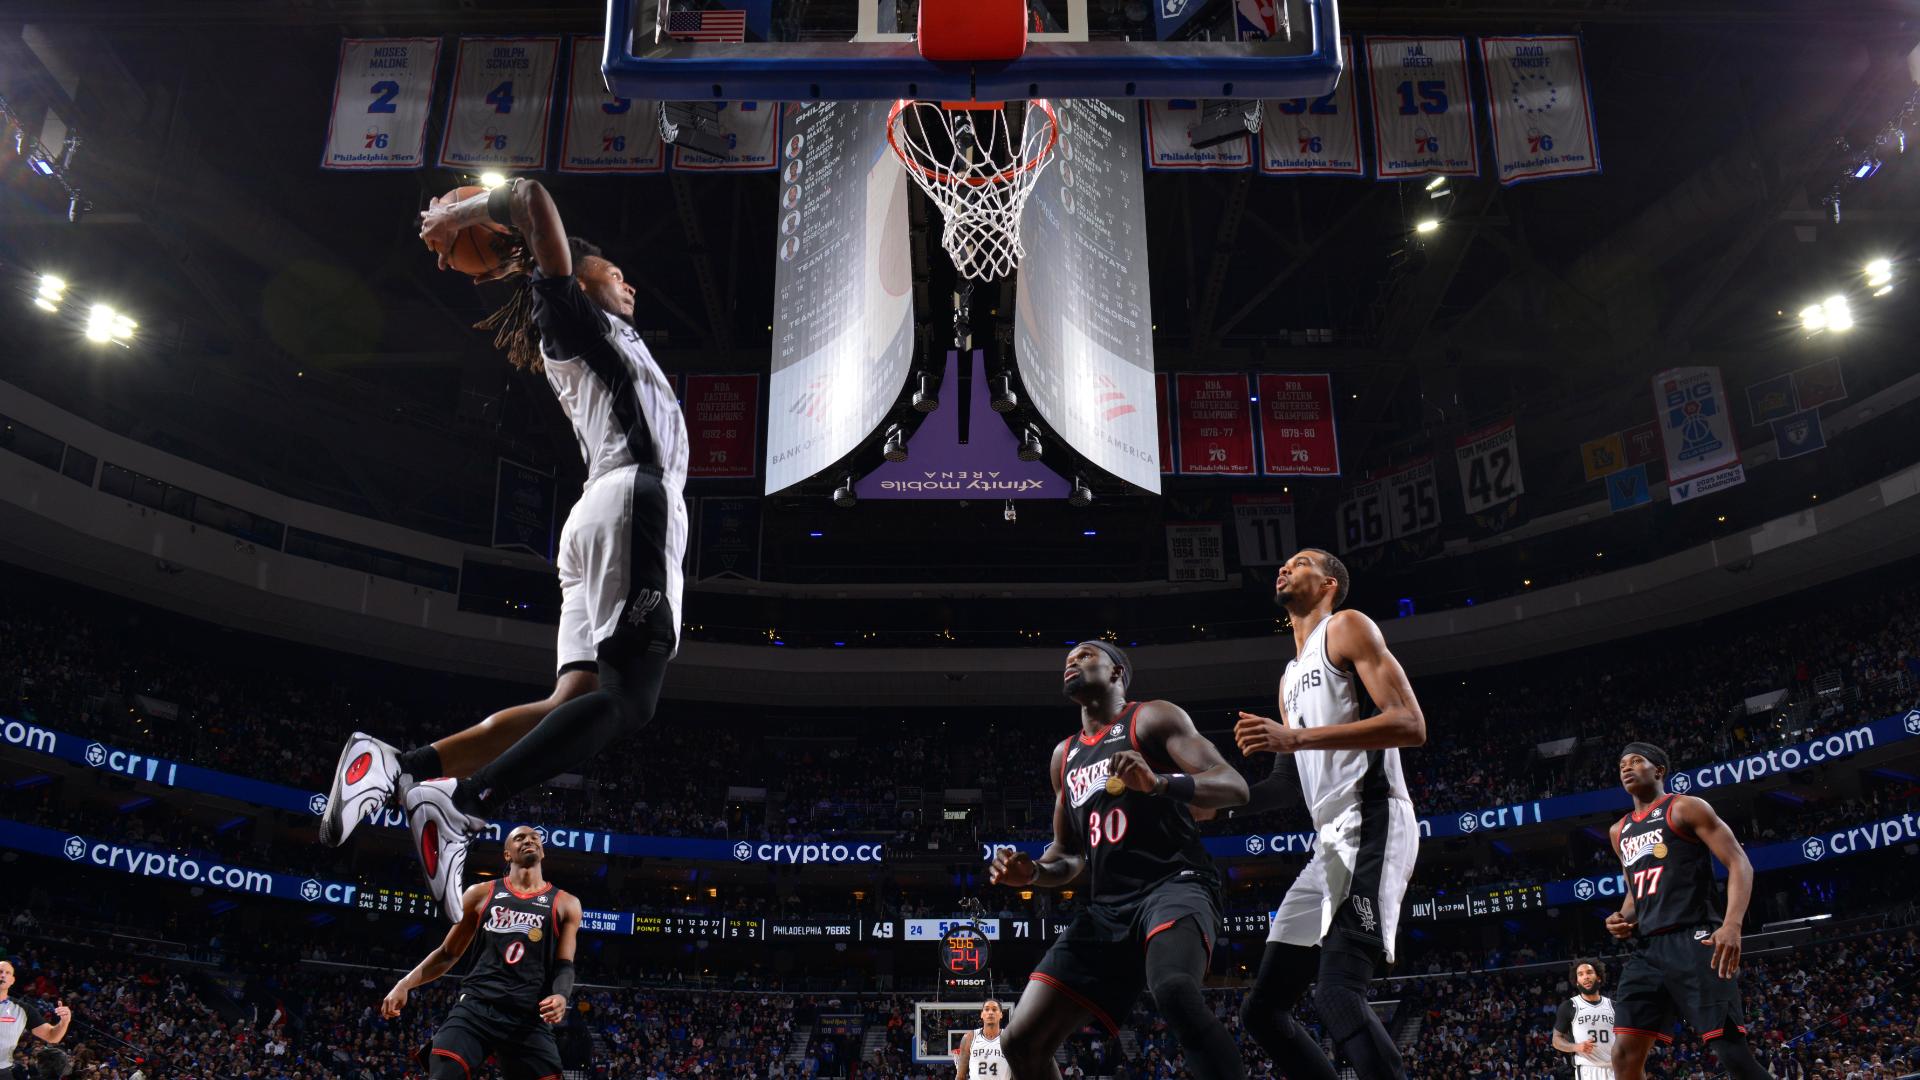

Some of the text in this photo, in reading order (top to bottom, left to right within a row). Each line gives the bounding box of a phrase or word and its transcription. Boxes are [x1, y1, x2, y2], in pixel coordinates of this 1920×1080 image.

[374, 47, 407, 57] MOSES
[493, 47, 525, 57] DOLPH
[1407, 46, 1426, 56] HAL
[1515, 46, 1544, 57] DAVID
[369, 58, 408, 69] MALONE
[486, 58, 529, 69] SCHAYES
[1402, 57, 1434, 68] GREER
[1511, 57, 1551, 68] ZINKOFF
[367, 80, 400, 114] 2
[485, 80, 514, 114] 4
[1397, 80, 1448, 116] 15
[806, 122, 827, 141] MAXEY
[365, 133, 390, 149] 76
[483, 134, 507, 150] 76
[602, 135, 626, 152] 76
[1298, 136, 1323, 154] 76
[1415, 136, 1439, 153] 76
[1527, 134, 1553, 154] 76
[333, 153, 415, 162] Philadelphia 76ers
[452, 153, 507, 163] Philadelphia
[741, 154, 766, 163] 76ers
[805, 143, 833, 166] EDWARDS
[1160, 152, 1242, 162] Philadelphia 76ers
[571, 156, 654, 166] Philadelphia 76ers
[1270, 159, 1353, 169] Philadelphia 76ers
[1388, 158, 1469, 169] Philadelphia 76ers
[1504, 154, 1585, 172] Philadelphia 76ers
[804, 169, 833, 191] WATFORD
[803, 203, 820, 218] BONA
[798, 232, 850, 273] TEAM STATS
[1073, 231, 1128, 273] TEAM STATS
[789, 310, 816, 329] TEAM
[1094, 298, 1136, 329] LEADERS
[782, 346, 795, 357] BLK
[714, 381, 732, 392] NBA
[1204, 381, 1222, 390] NBA
[1285, 382, 1302, 391] NBA
[704, 391, 740, 402] EASTERN
[1196, 390, 1233, 399] EASTERN
[1276, 391, 1313, 401] EASTERN
[1667, 383, 1712, 407] BIG
[696, 401, 747, 411] CONFERENCE
[1190, 400, 1241, 410] CONFERENCE
[1271, 401, 1320, 411] CONFERENCE
[697, 410, 745, 422] CHAMPIONS
[1191, 410, 1239, 420] CHAMPIONS
[1272, 411, 1320, 421] CHAMPIONS
[702, 428, 738, 439] 1982-83
[1200, 427, 1234, 438] 1976-77
[1280, 427, 1316, 439] 1979-80
[772, 445, 799, 465] BANK
[1107, 434, 1154, 465] AMERICA
[1208, 449, 1227, 462] 76
[709, 449, 727, 464] 76
[1290, 449, 1309, 463] 76
[1189, 464, 1250, 472] Philadelphia 76ers
[1271, 464, 1331, 473] Philadelphia 76ers
[924, 471, 1001, 479] ARENA
[1469, 449, 1515, 504] 42
[1715, 469, 1741, 482] MEN'S
[880, 479, 961, 492] mobile
[1398, 478, 1434, 532] 35
[1344, 496, 1382, 548] 66
[1251, 519, 1283, 560] 11
[1696, 725, 1875, 789] crypto.com
[1089, 808, 1128, 849] 30
[1830, 814, 1920, 855] crypt
[91, 843, 272, 894] crypto.com
[1633, 866, 1664, 900] 77
[360, 892, 374, 901] PHI
[380, 895, 389, 903] 18
[1473, 891, 1541, 908] PHI 18 10 4 4
[358, 900, 374, 909] SAS
[378, 903, 388, 911] 26
[394, 904, 402, 912] 17
[423, 908, 429, 916] 4
[1412, 903, 1465, 918] JULY 9:17 PM
[1473, 900, 1542, 916] SAS 26 17 6 4
[603, 912, 621, 921] NOW!
[636, 917, 661, 925] PLAYER
[699, 919, 709, 927] 30
[711, 920, 720, 928] 77
[1244, 915, 1254, 923] 24
[591, 920, 616, 932] $9,180
[636, 925, 672, 934] POINTS 15
[773, 922, 894, 939] PHILADELPHIA 76ERS 49
[910, 925, 996, 936] 24 2ND
[1012, 921, 1029, 938] 71
[731, 927, 755, 938] 5 3
[949, 938, 974, 949] 50.6
[505, 941, 526, 965] 0
[951, 949, 979, 971] 24
[956, 979, 986, 987] TISSOT
[1577, 1014, 1615, 1026] SPURS
[1587, 1029, 1609, 1044] 30
[978, 1062, 998, 1076] 24
